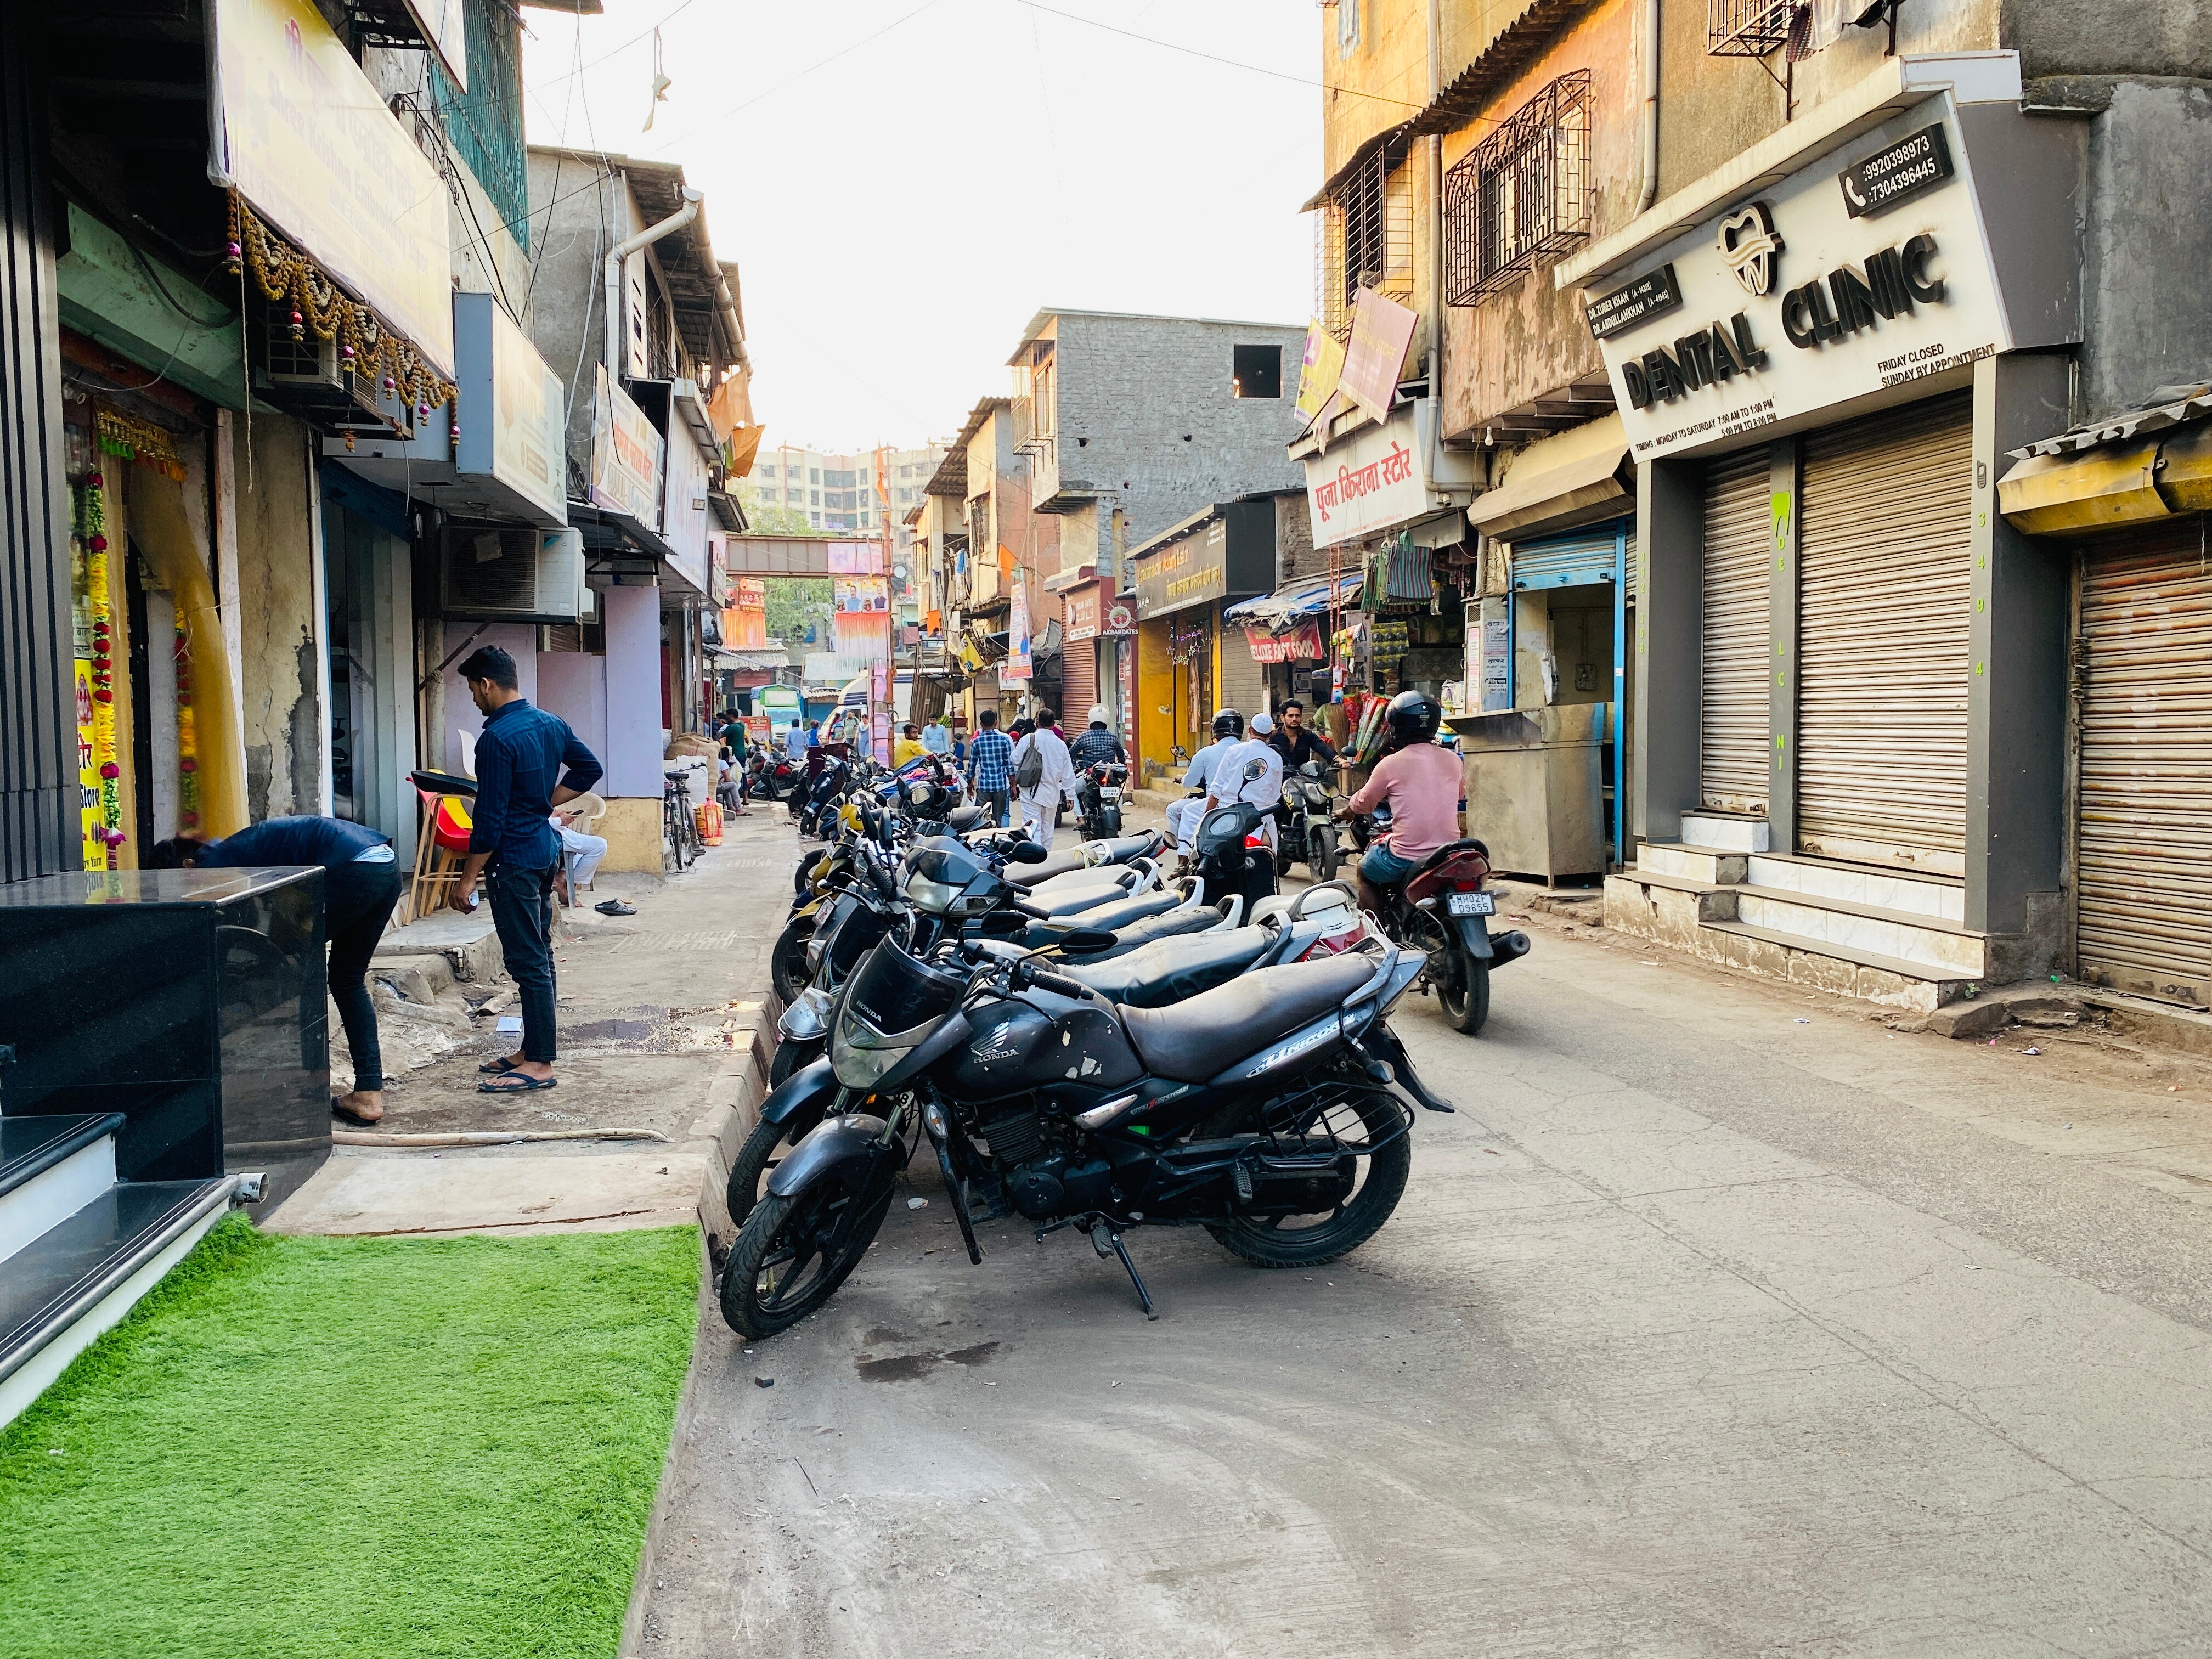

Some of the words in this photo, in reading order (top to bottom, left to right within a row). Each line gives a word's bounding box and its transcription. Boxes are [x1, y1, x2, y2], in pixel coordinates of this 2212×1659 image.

[1613, 290, 1629, 308] KHAN
[1622, 311, 1765, 410] DENTAL
[1781, 233, 1944, 348] CLINIC
[1877, 354, 1906, 373] FRIDAY
[1908, 343, 1944, 363] CLOSED
[1882, 368, 1915, 388] SUNDAY
[1916, 364, 1928, 377] BY
[1930, 343, 1995, 374] APPOINTMENT
[1655, 431, 1678, 445] MONDAY
[1678, 429, 1686, 438] TO
[1687, 419, 1716, 436] SATURDAY
[1717, 414, 1730, 425] 7:00
[1730, 410, 1740, 421] AM
[1740, 408, 1749, 417] TO
[1750, 403, 1763, 414] 1:00
[1763, 399, 1774, 410] PM
[1734, 424, 1743, 433] PM
[1743, 420, 1753, 430] TO
[1767, 413, 1778, 423] PM
[1315, 481, 1339, 522] पूजा
[1339, 465, 1380, 503] किराना
[1381, 441, 1412, 486] स्टोर
[1274, 640, 1291, 660] FAST
[1291, 640, 1315, 658] FOOD
[90, 856, 102, 867] Yarn
[1459, 903, 1489, 913] D9655
[856, 999, 882, 1023] HONDA
[973, 1048, 1019, 1064] HONDA
